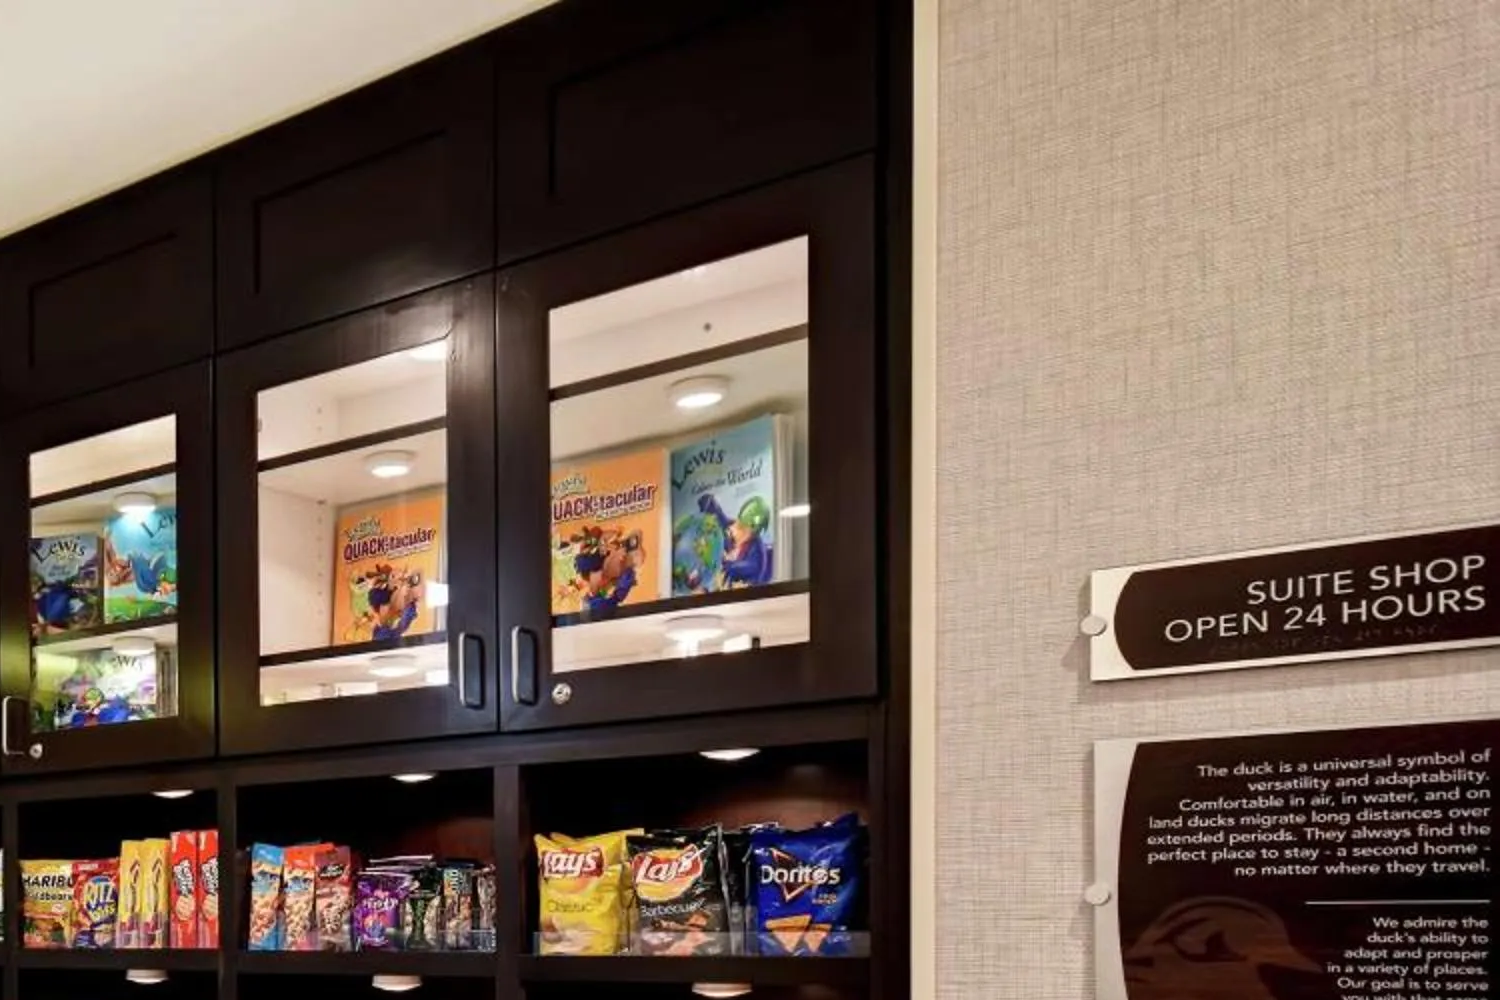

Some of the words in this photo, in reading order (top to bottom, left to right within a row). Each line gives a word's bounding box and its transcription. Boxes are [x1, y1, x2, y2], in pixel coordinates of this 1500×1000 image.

[672, 440, 725, 491] Lewis
[727, 460, 764, 486] World
[552, 484, 657, 521] UACK-tacular
[32, 536, 85, 564] Lewis
[1247, 570, 1353, 605] SUITE
[1369, 555, 1486, 591] SHOP
[1165, 609, 1268, 642] OPEN
[1284, 604, 1326, 631] 24
[1342, 586, 1486, 624] HOURS
[1198, 765, 1228, 778] The
[1234, 763, 1273, 776] duck
[1279, 762, 1292, 774] is
[1298, 763, 1307, 773] a
[1314, 755, 1392, 772] universal
[1397, 750, 1465, 770] symbol
[1471, 749, 1491, 763] of
[1248, 776, 1329, 792] versatility
[1336, 774, 1369, 787] and
[1375, 769, 1490, 787] adaptability.
[1179, 794, 1284, 811] Comfortable
[1290, 794, 1305, 806] in
[1310, 793, 1335, 807] air,
[1341, 792, 1357, 804] in
[1363, 790, 1417, 804] water,
[1424, 787, 1460, 801] and
[1466, 788, 1490, 800] on
[1150, 815, 1183, 829] land
[1188, 813, 1235, 827] ducks
[1241, 811, 1306, 828] migrate
[1312, 810, 1350, 826] long
[1356, 807, 1442, 822] distances
[1449, 807, 1491, 819] over
[1147, 830, 1224, 845] extended
[1229, 829, 1297, 846] periods.
[1304, 827, 1346, 844] They
[1351, 825, 1411, 841] always
[1417, 824, 1453, 837] find
[1459, 823, 1491, 836] the
[1148, 847, 1206, 864] perfect
[1212, 847, 1256, 864] place
[1261, 847, 1279, 859] to
[1284, 846, 1319, 861] stay
[1337, 847, 1346, 857] a
[1352, 843, 1418, 857] second
[1424, 842, 1479, 855] home
[761, 862, 841, 884] Doritos
[1235, 866, 1257, 877] no
[1261, 864, 1319, 876] matter
[1325, 862, 1380, 874] where
[1386, 861, 1425, 877] they
[1431, 859, 1490, 872] travel.
[1373, 917, 1398, 929] We
[1403, 917, 1457, 929] admire
[1462, 917, 1488, 929] the
[1367, 933, 1415, 943] duck's
[1420, 933, 1466, 947] ability
[1471, 933, 1488, 944] to
[1344, 948, 1388, 962] adapt
[1393, 947, 1422, 959] and
[1427, 949, 1488, 964] prosper
[1327, 963, 1340, 973] in
[1344, 965, 1353, 973] a
[1358, 963, 1408, 977] variety
[1413, 963, 1429, 975] of
[1434, 963, 1488, 977] places.
[1337, 978, 1366, 989] Our
[1371, 978, 1403, 992] goal
[1408, 979, 1420, 990] is
[1425, 980, 1440, 991] to
[1445, 982, 1488, 991] serve
